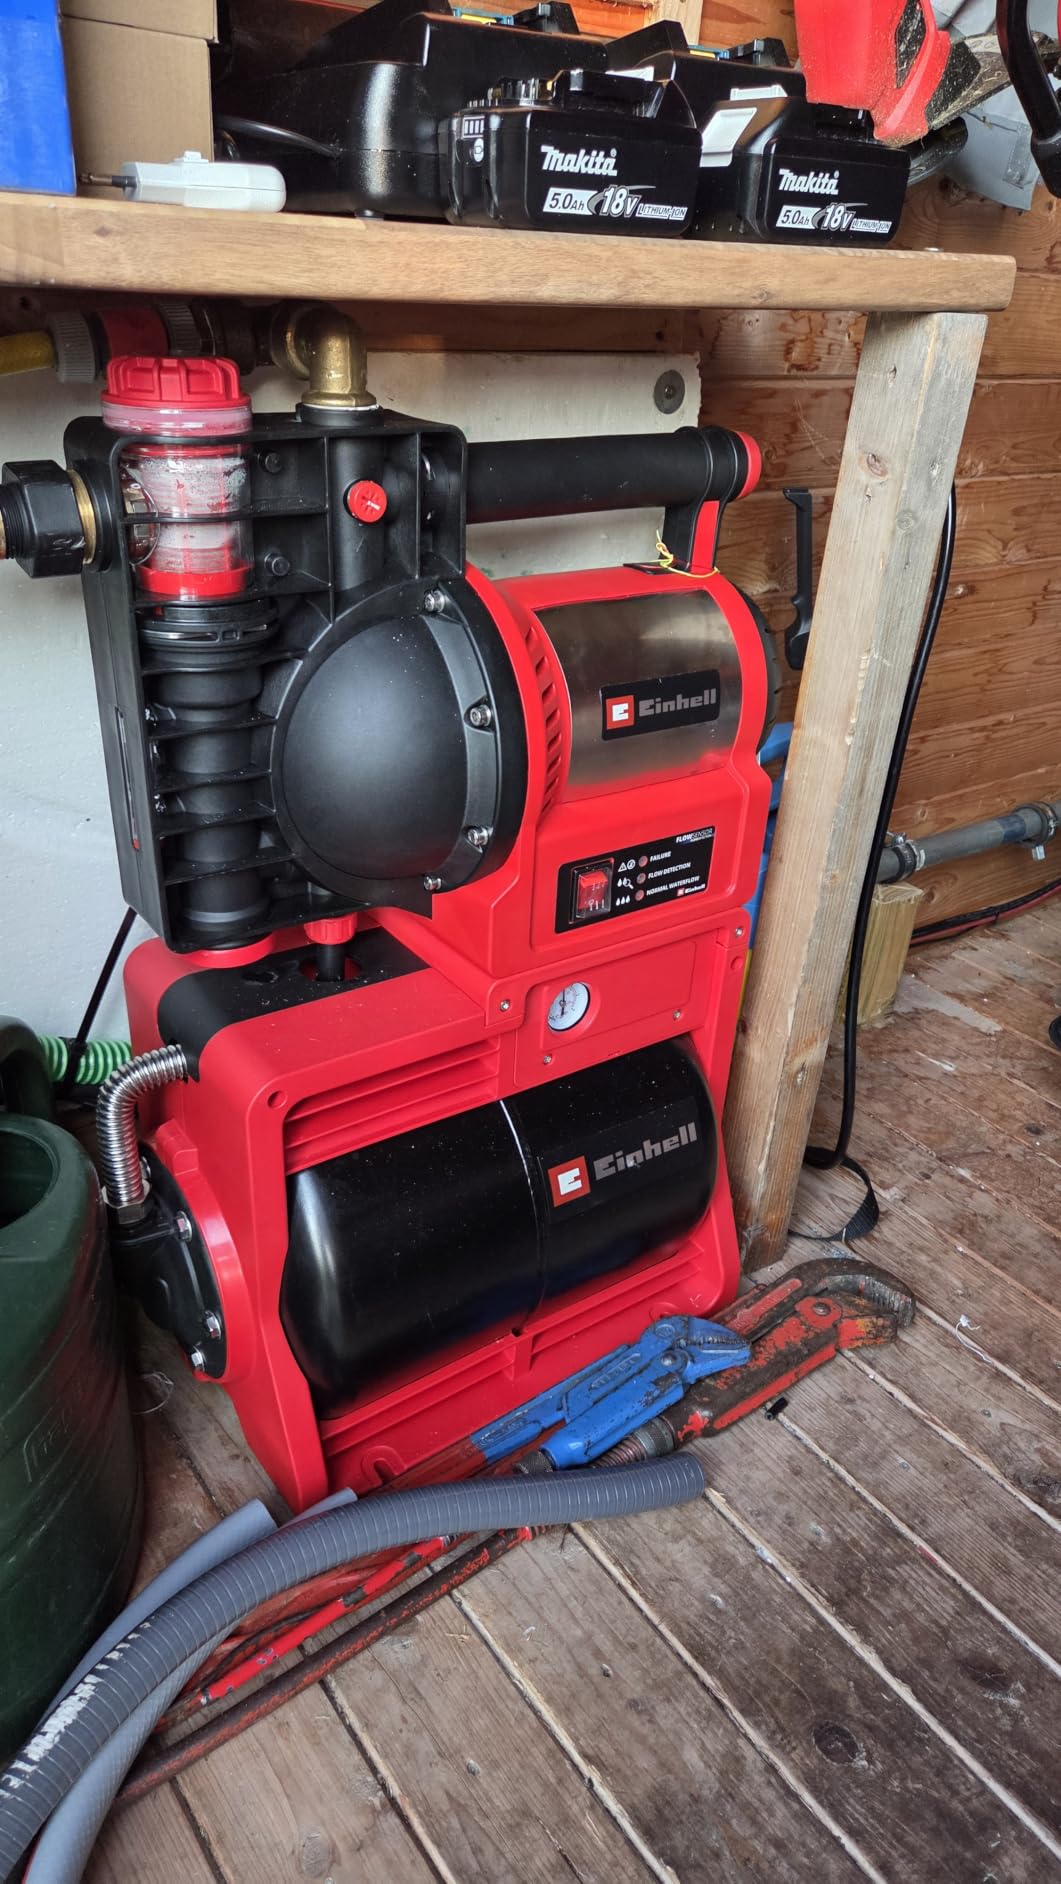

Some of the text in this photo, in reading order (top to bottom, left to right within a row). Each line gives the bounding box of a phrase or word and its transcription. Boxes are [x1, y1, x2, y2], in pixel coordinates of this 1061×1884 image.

[541, 145, 618, 177] Makita
[779, 168, 839, 195] Makita
[549, 192, 585, 212] 5.0Ah
[780, 209, 810, 225] 5.0Ah
[638, 688, 717, 717] Einhell
[650, 850, 672, 862] FAILURE
[648, 861, 692, 879] FLOW DETECTION
[646, 875, 700, 896] NORMAL WATERFLOW
[593, 1121, 698, 1181] Einhell
